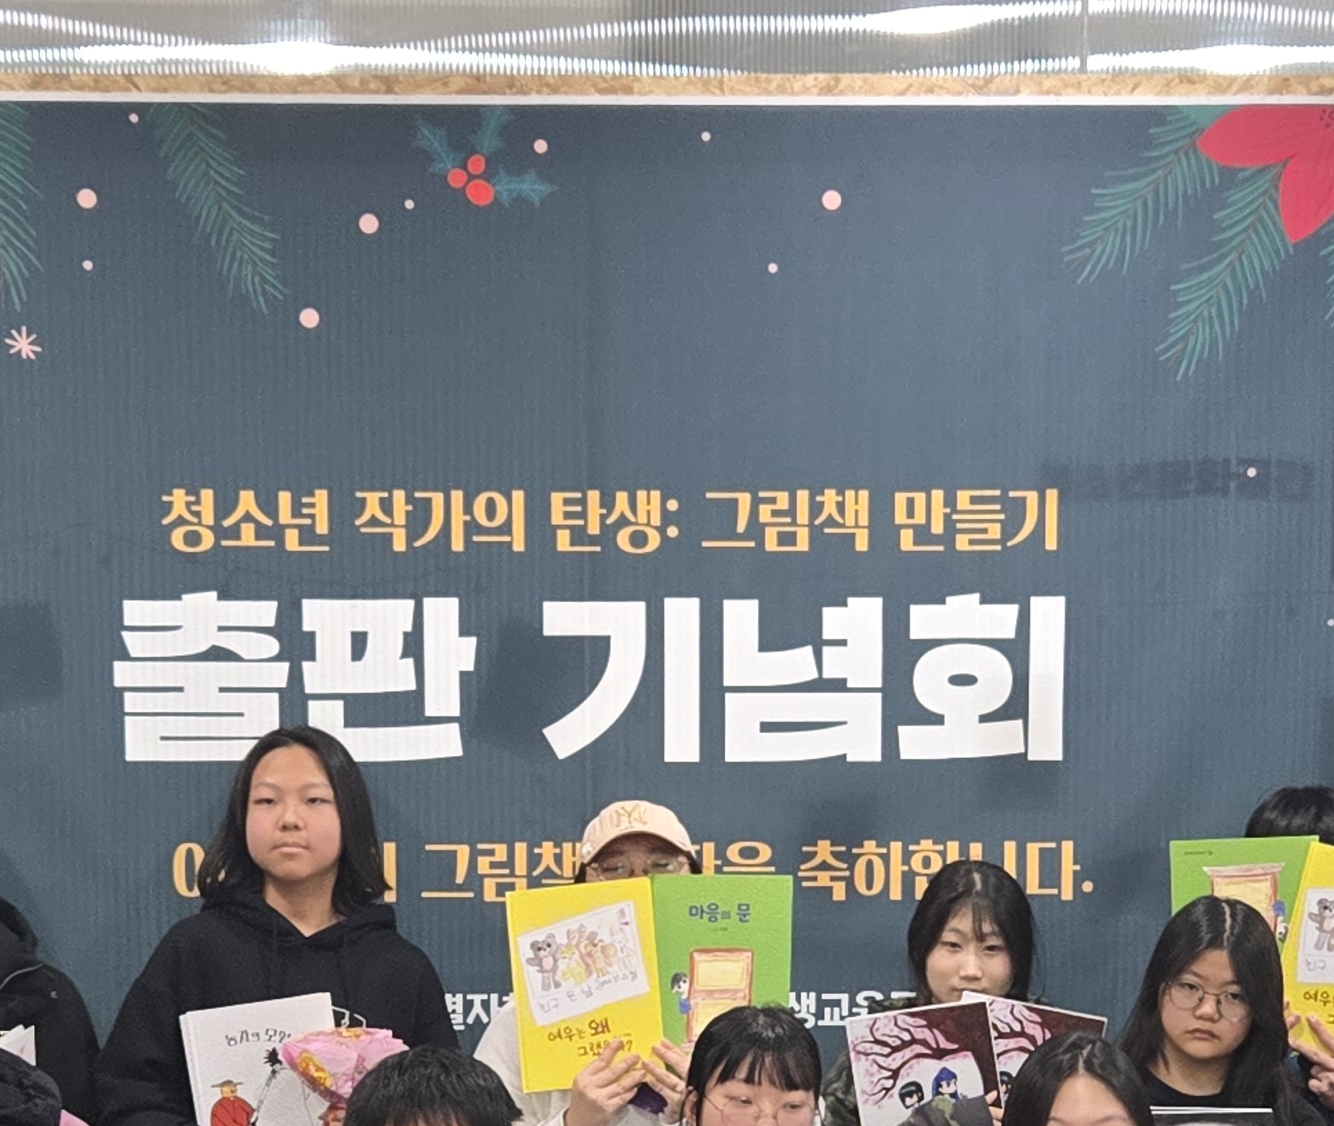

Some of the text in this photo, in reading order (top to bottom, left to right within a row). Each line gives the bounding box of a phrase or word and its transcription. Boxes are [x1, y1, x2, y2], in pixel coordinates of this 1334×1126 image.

[161, 489, 1060, 552] 청소년 작가의 탄생: 그림책 만들기
[113, 590, 1065, 762] 출판 기념회
[735, 903, 752, 923] 문
[445, 993, 515, 1031] 별자
[588, 1017, 611, 1037] 왜
